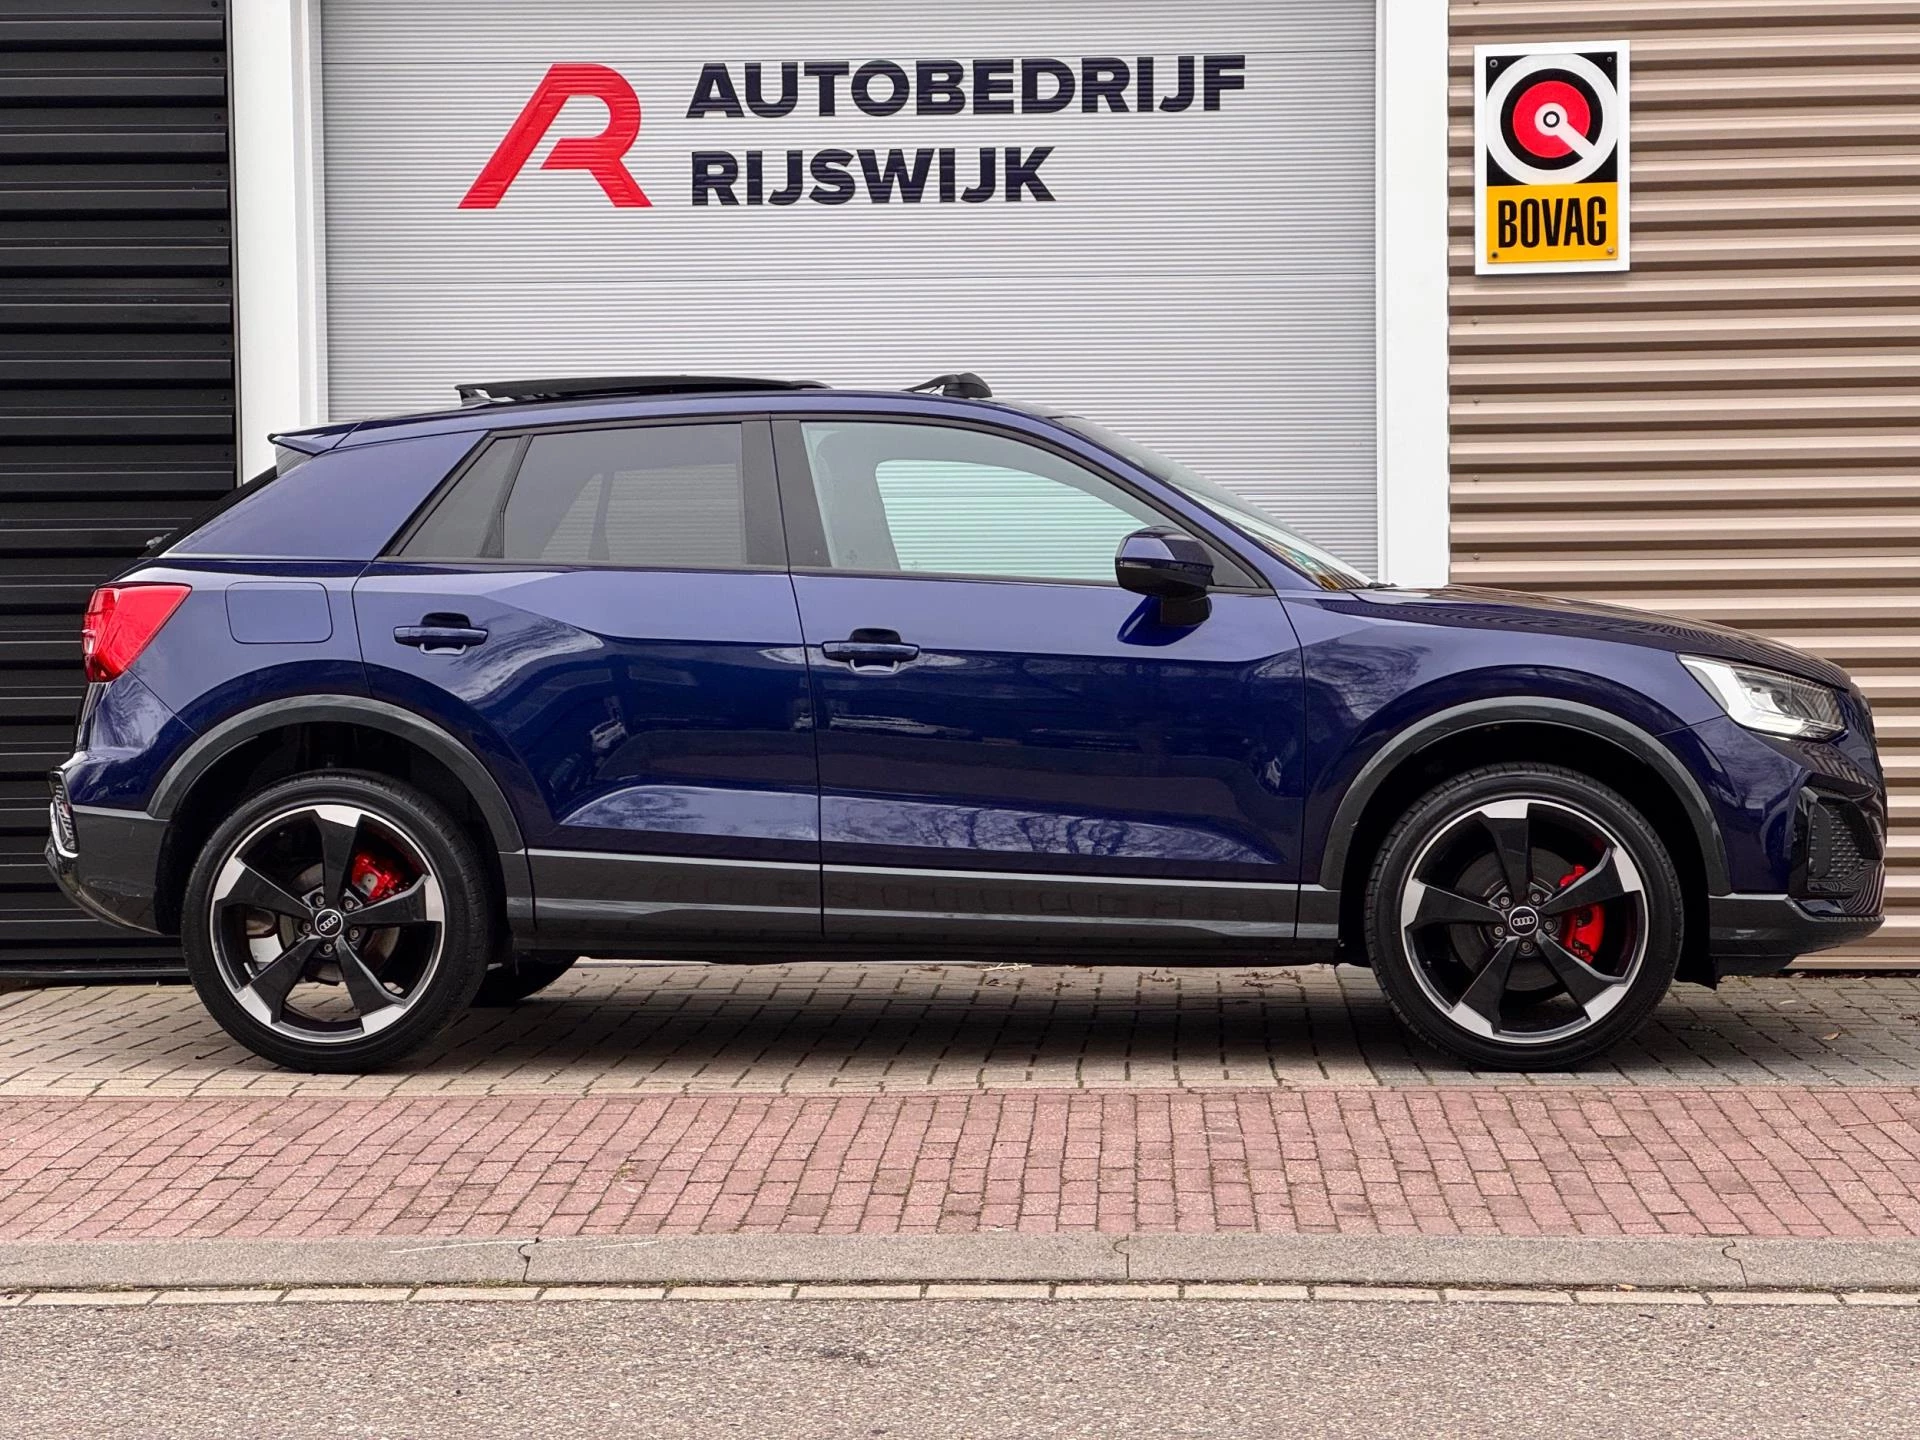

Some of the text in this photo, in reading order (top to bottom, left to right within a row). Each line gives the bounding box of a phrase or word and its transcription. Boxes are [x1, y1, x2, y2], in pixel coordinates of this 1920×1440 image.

[686, 55, 1246, 119] AUTOBEDRIJF
[692, 146, 1055, 207] RIJSWIJK
[1498, 196, 1607, 248] BOVAG
